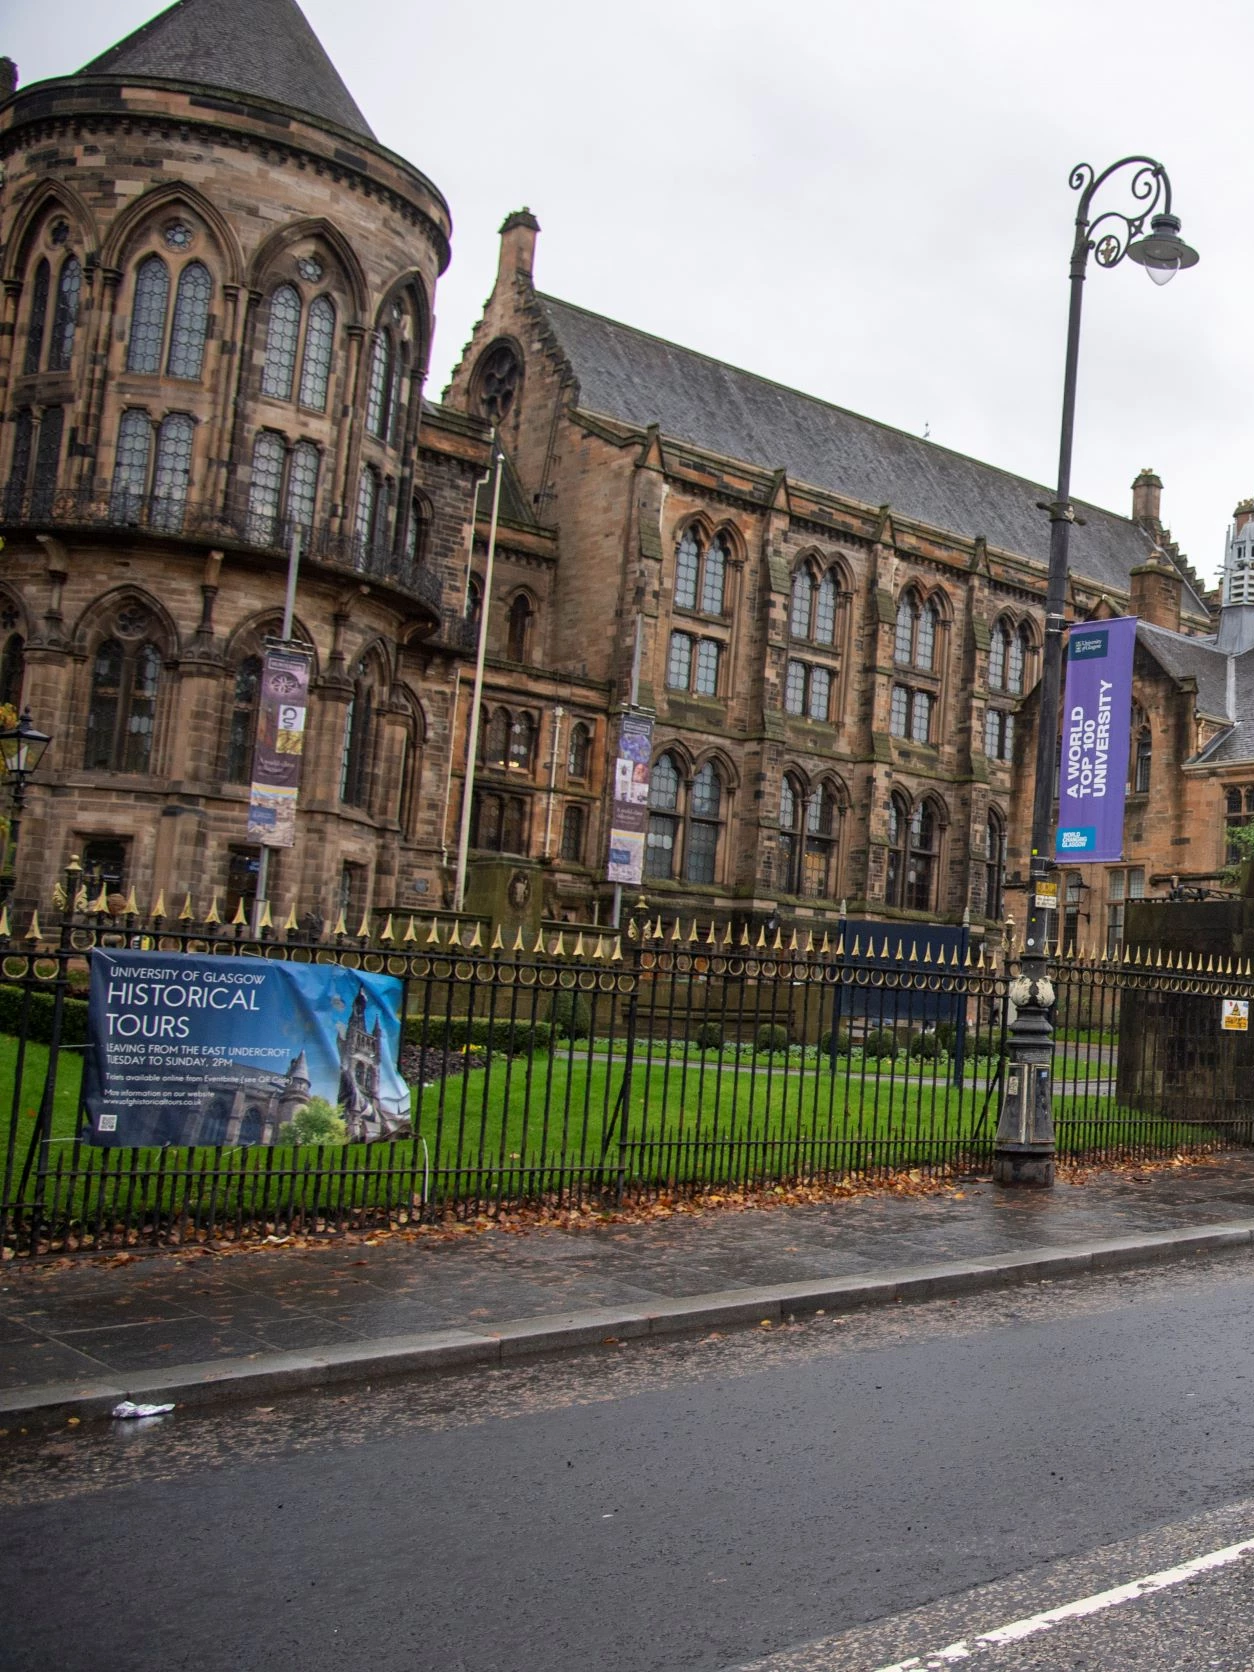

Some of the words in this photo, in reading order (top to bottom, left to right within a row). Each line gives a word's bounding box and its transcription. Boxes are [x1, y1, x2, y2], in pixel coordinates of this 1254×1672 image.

[1067, 706, 1084, 781] WORLD
[1083, 719, 1096, 753] 100
[1092, 679, 1113, 798] UNIVERSITY
[1079, 757, 1093, 799] TOP
[1067, 783, 1079, 799] A
[110, 966, 179, 981] UNIVERSITY
[182, 970, 200, 982] OF
[202, 972, 266, 985] GLASGOW
[107, 982, 260, 1011] HISTORICAL
[106, 1013, 190, 1038] TOURS
[106, 1043, 146, 1054] LEAVING
[148, 1044, 178, 1054] FROM
[181, 1046, 200, 1055] THE
[202, 1046, 226, 1056] EAST
[228, 1047, 290, 1057] UNDERCROFT
[106, 1054, 146, 1065] TUESDAY
[148, 1056, 162, 1066] TO
[165, 1056, 209, 1068] SUNDAY,
[212, 1058, 233, 1067] 2PM
[126, 1073, 160, 1082] available
[162, 1074, 184, 1083] online
[186, 1074, 203, 1083] from
[187, 1090, 216, 1098] website
